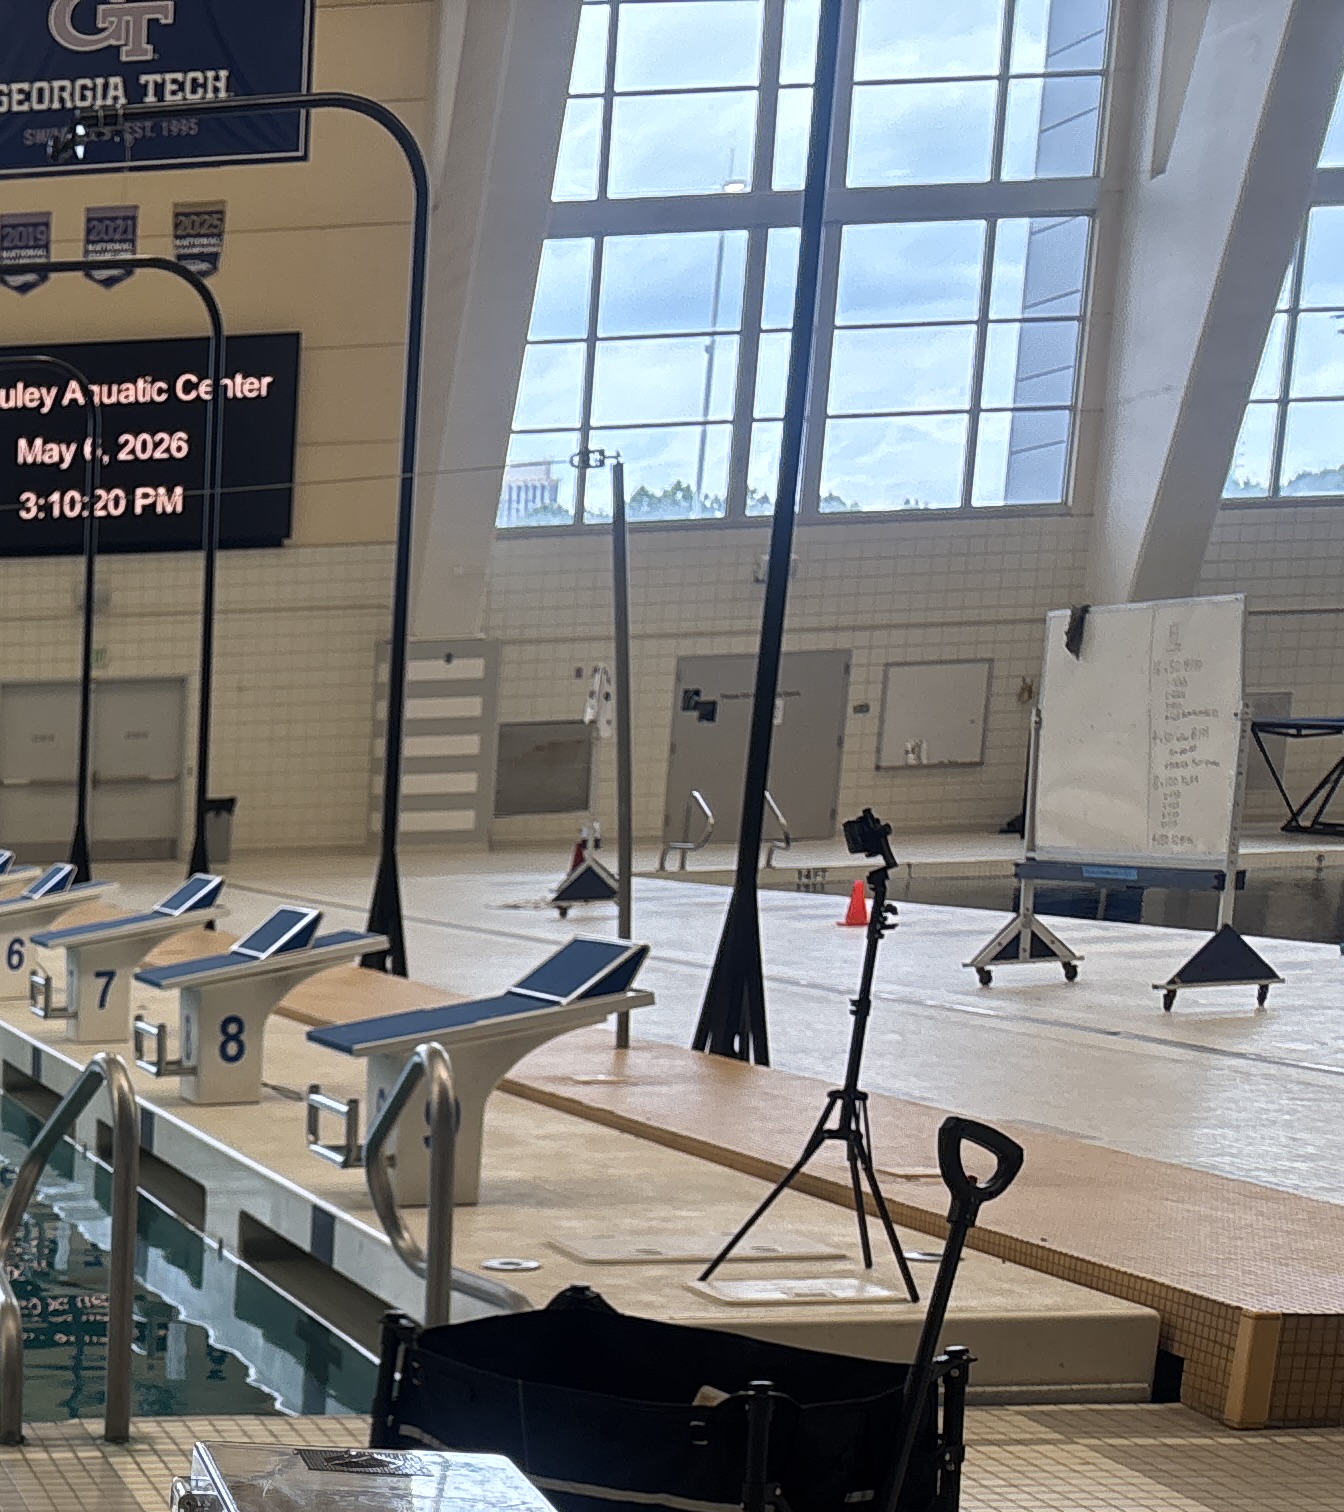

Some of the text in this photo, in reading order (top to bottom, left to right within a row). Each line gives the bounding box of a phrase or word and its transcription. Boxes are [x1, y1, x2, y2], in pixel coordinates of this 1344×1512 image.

[139, 69, 230, 103] TECH
[2, 225, 47, 247] 2019
[88, 219, 133, 241] 2021
[175, 214, 223, 235] 2025
[175, 372, 274, 401] Center
[17, 437, 78, 470] May
[117, 431, 189, 461] 2026
[18, 486, 185, 521] 3:10:20 PM
[7, 937, 26, 970] 6
[94, 970, 116, 1009] 7
[219, 1014, 245, 1063] 8
